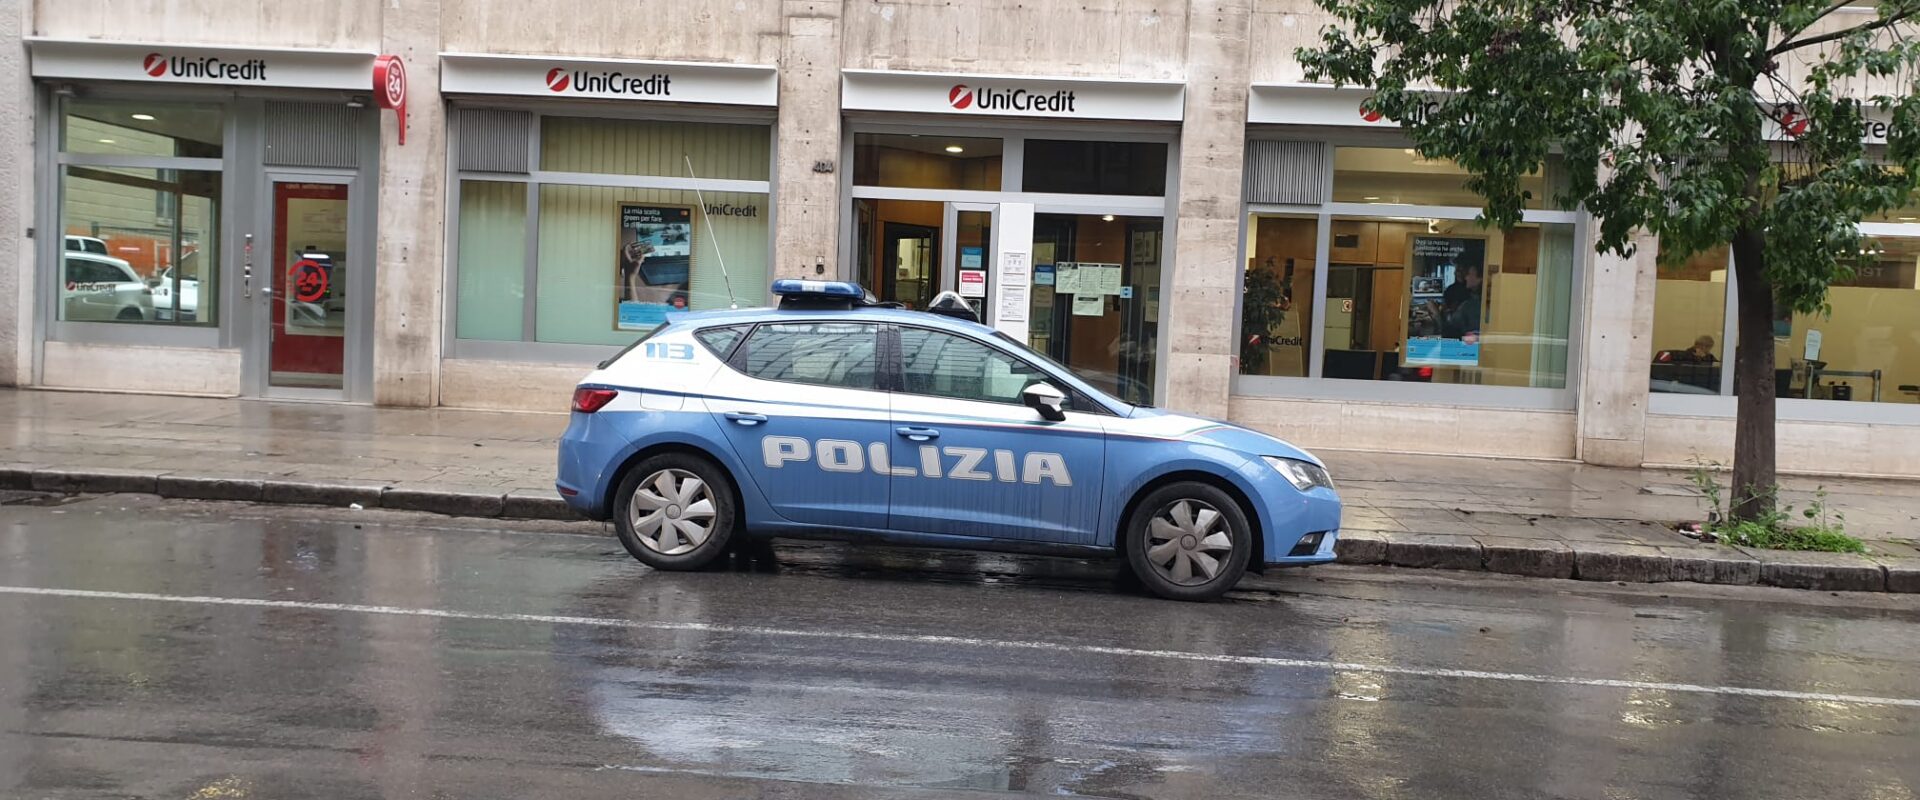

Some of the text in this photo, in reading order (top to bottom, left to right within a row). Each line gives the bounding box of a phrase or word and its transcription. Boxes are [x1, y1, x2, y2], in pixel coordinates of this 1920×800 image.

[171, 56, 267, 81] UniCredit
[389, 74, 401, 95] 24
[574, 70, 671, 96] UniCredit
[977, 87, 1075, 113] UniCredit
[704, 202, 757, 218] UniCredit
[296, 271, 319, 287] 24
[644, 342, 694, 360] 113
[762, 435, 1073, 487] POLIZIA
